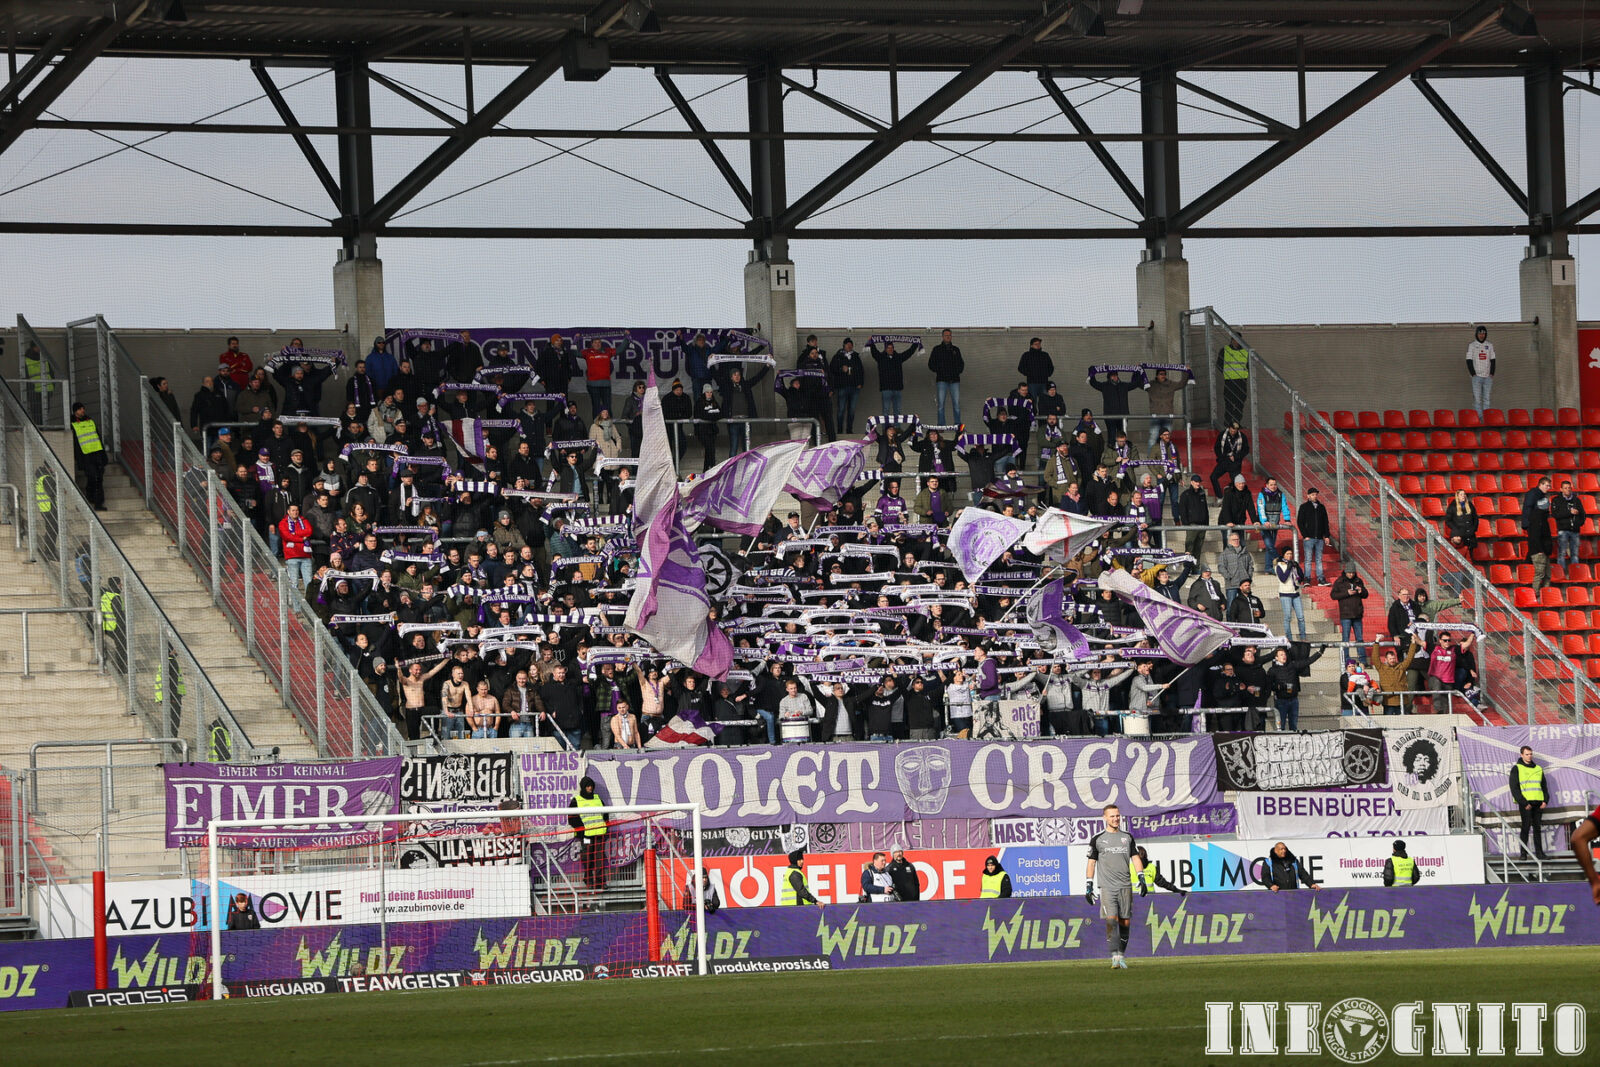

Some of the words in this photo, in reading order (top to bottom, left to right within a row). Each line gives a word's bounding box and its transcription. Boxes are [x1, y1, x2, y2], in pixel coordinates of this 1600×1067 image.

[776, 269, 789, 286] H
[893, 664, 924, 672] VIOLET
[931, 662, 957, 671] CREW
[812, 673, 843, 683] VIOLET
[853, 675, 882, 684] CREW
[521, 752, 579, 772] ULTRAS
[218, 766, 258, 777] EIMER
[266, 766, 285, 777] IST
[293, 765, 348, 777] KEINMAL
[587, 751, 882, 822] VIOLET
[967, 736, 1200, 813] CREW
[523, 774, 578, 792] PASSION
[172, 783, 353, 830] EIMER
[1256, 794, 1402, 817] IBBENBÜREN
[1130, 813, 1210, 833] Fighters
[252, 836, 298, 848] SAUFEN
[311, 833, 381, 847] SCHMEISSEN
[750, 829, 781, 840] GUYS
[994, 822, 1036, 844] HASE
[439, 836, 521, 860] LILA-WEISSE
[1018, 857, 1060, 872] Parsberg
[1340, 858, 1361, 868] Finde
[1015, 872, 1061, 884] Ingolstadt
[388, 890, 415, 902] deine
[417, 888, 475, 902] Ausbildung!
[105, 895, 209, 931] AZUBI
[631, 963, 694, 979] guSTAFF
[713, 959, 830, 975] produkte.prosis.de
[337, 972, 463, 993] TEAMGEIST
[492, 968, 585, 985] hildeGUARD
[245, 981, 326, 998] luitGUARD
